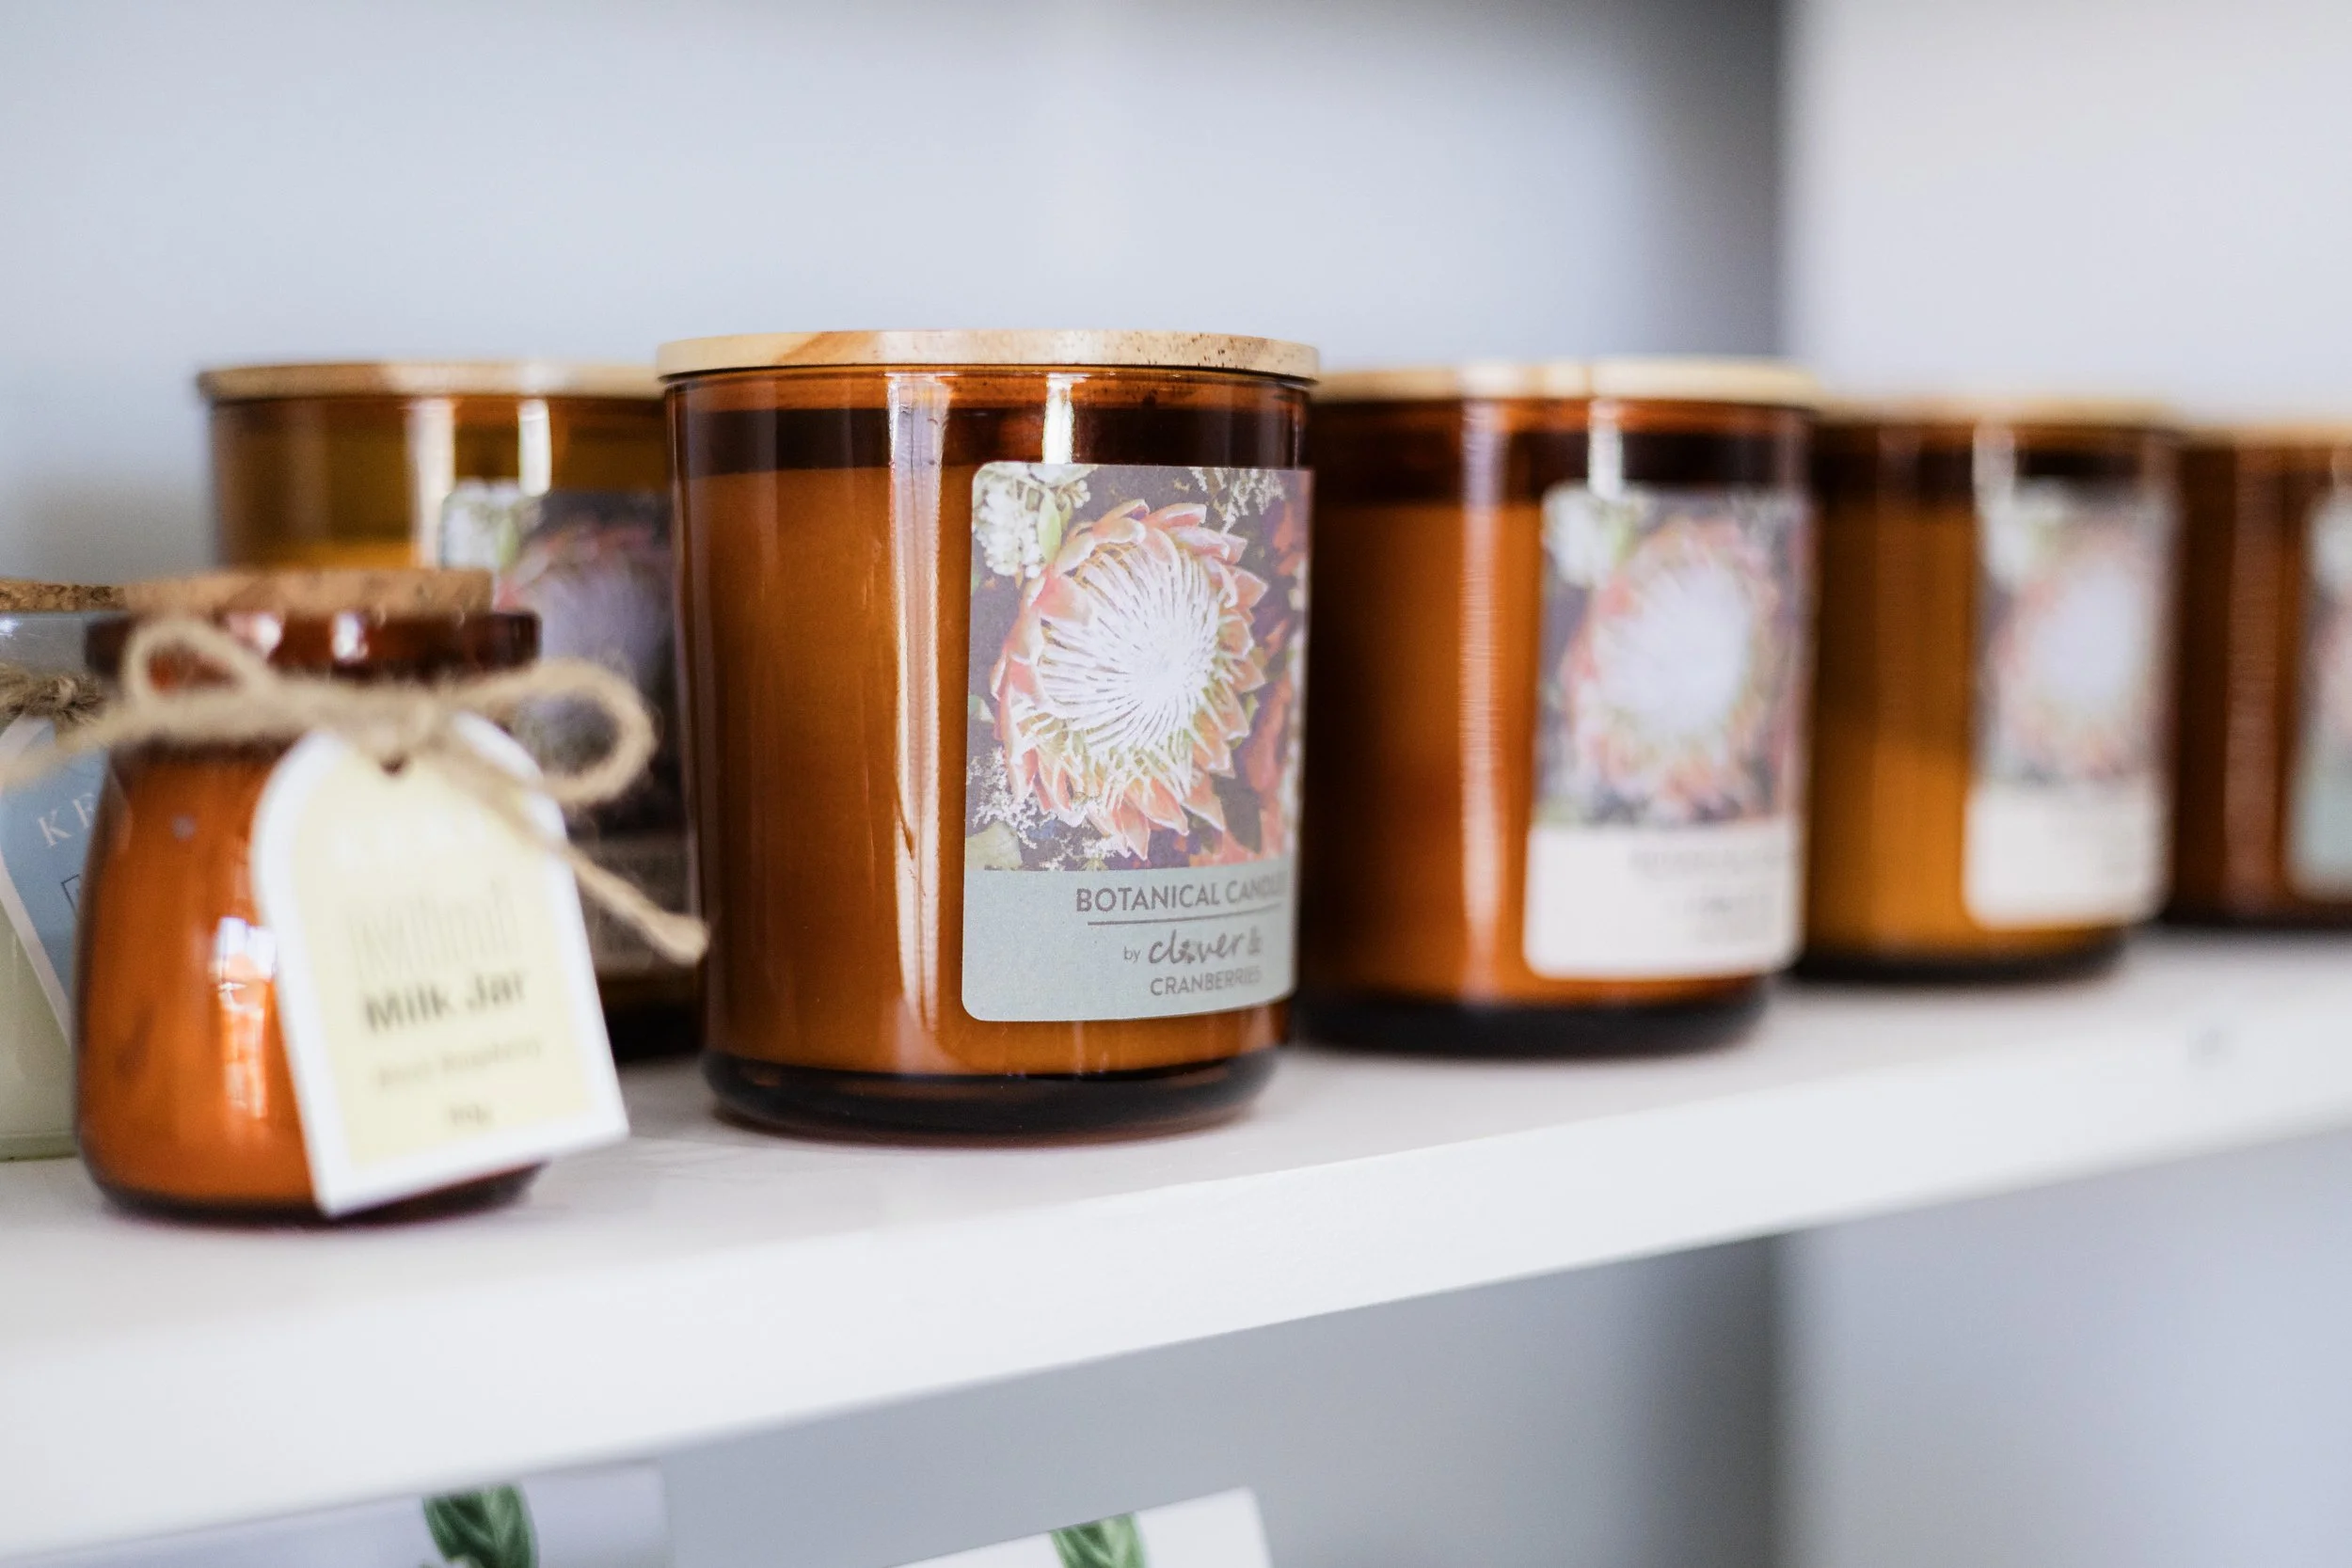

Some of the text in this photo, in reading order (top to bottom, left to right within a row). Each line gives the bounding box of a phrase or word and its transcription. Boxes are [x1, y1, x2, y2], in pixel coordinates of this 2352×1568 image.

[1075, 883, 1220, 912] BOTANICAL
[1123, 945, 1141, 962] by
[1150, 965, 1262, 996] CRANBERRIES
[362, 970, 528, 1034] Milk Jar
